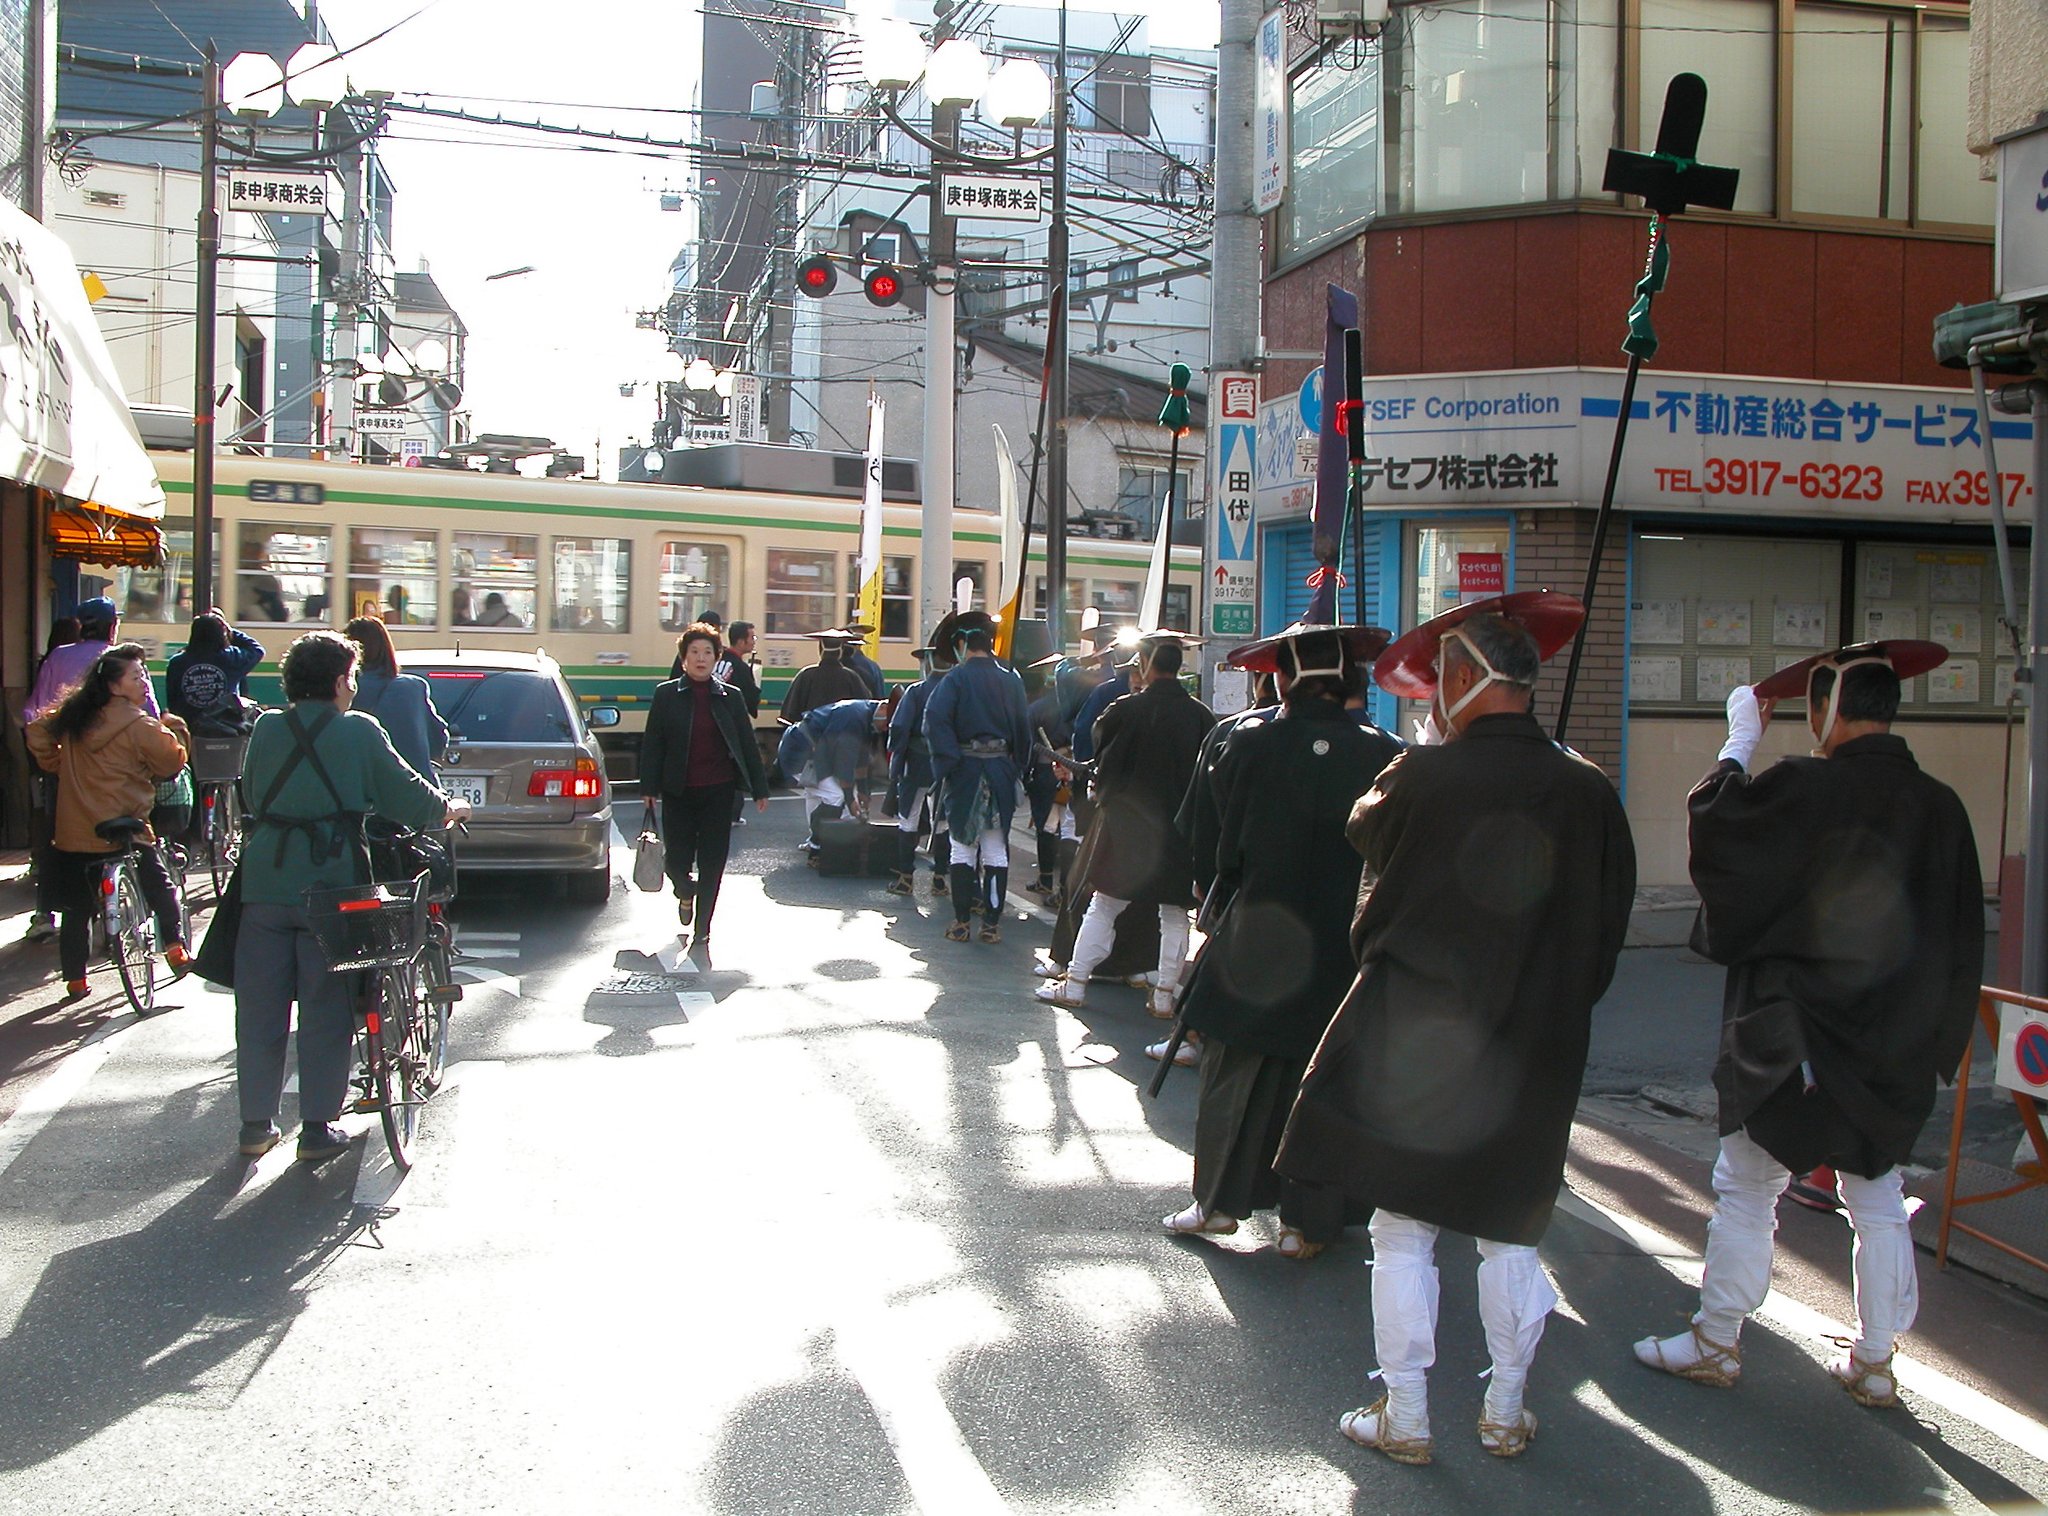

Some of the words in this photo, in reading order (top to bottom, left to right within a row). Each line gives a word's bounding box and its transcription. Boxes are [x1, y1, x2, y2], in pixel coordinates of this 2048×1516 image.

[232, 181, 324, 205] 庚申塚商栄会
[947, 186, 1038, 210] 庚申塚商栄会
[1226, 381, 1255, 416] 質
[1425, 392, 1559, 421] Corporation
[1655, 390, 1983, 448] 不動産総合サービス
[1362, 453, 1559, 491] テセフ株式会社
[1654, 468, 1702, 493] TEL
[1704, 458, 1884, 502] 3917-6323
[1906, 480, 1951, 504] FAX
[1228, 471, 1250, 521] 田代
[456, 779, 471, 787] 300
